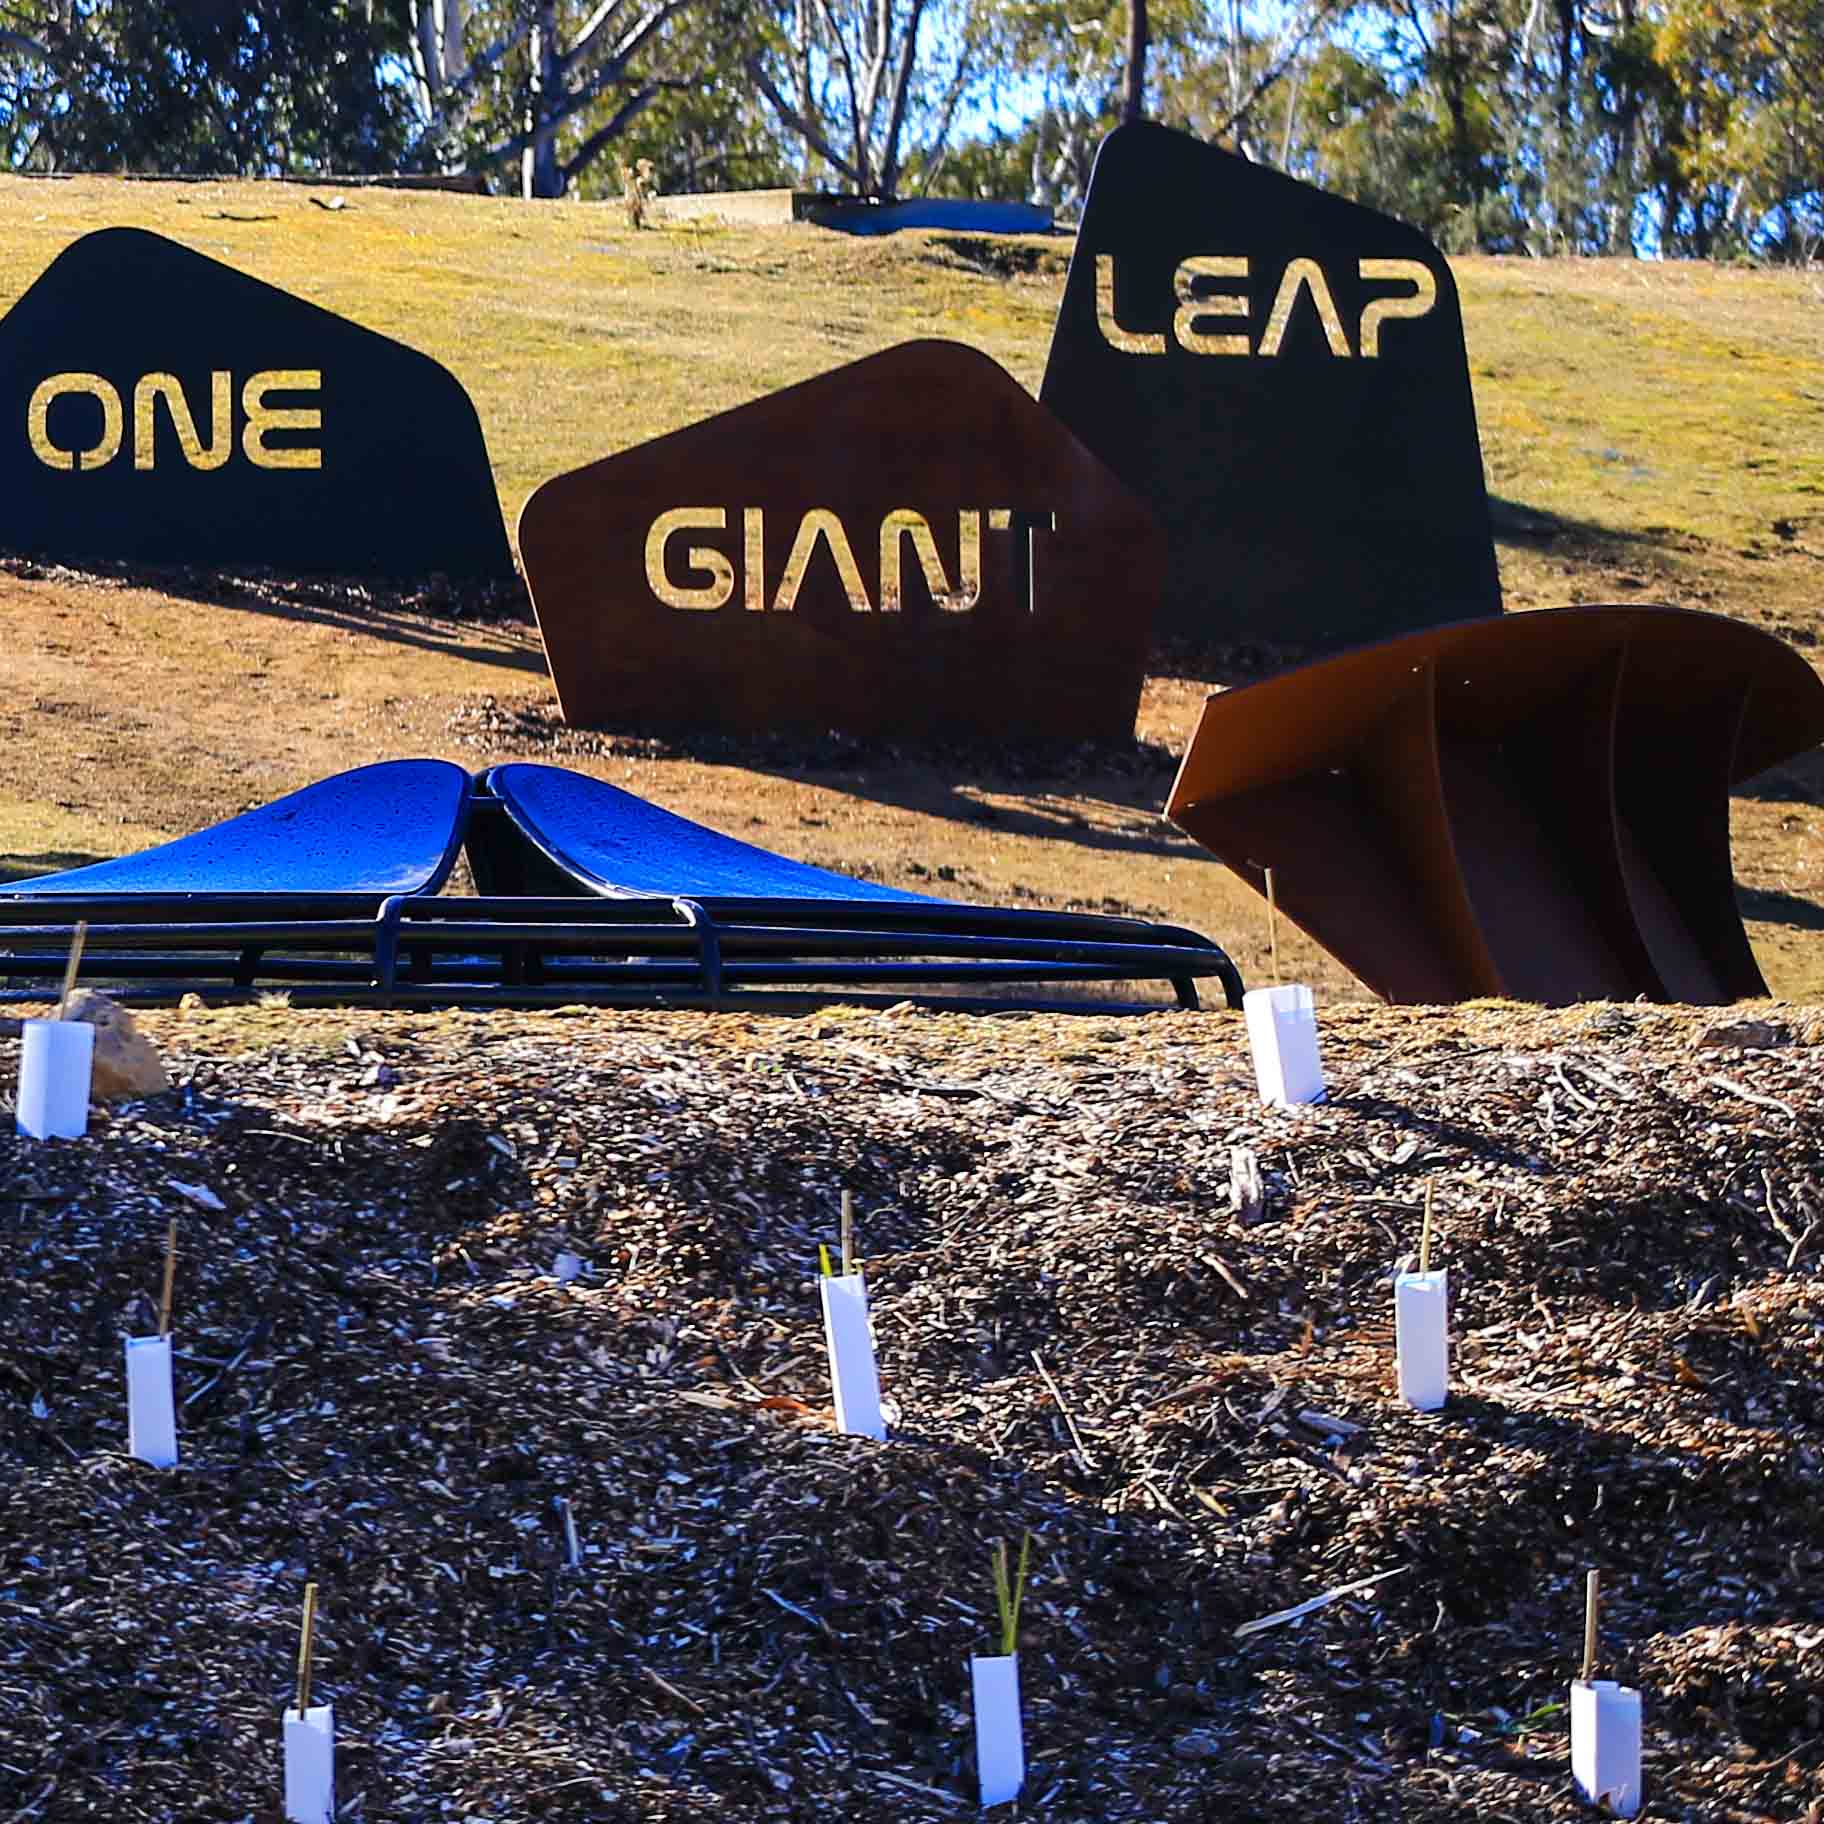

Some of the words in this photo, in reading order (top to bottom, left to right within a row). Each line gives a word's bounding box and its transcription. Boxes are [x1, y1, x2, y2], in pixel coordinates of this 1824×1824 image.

[1094, 253, 1437, 359] LEAP
[26, 368, 323, 471] ONE
[643, 505, 1057, 613] GIANT
